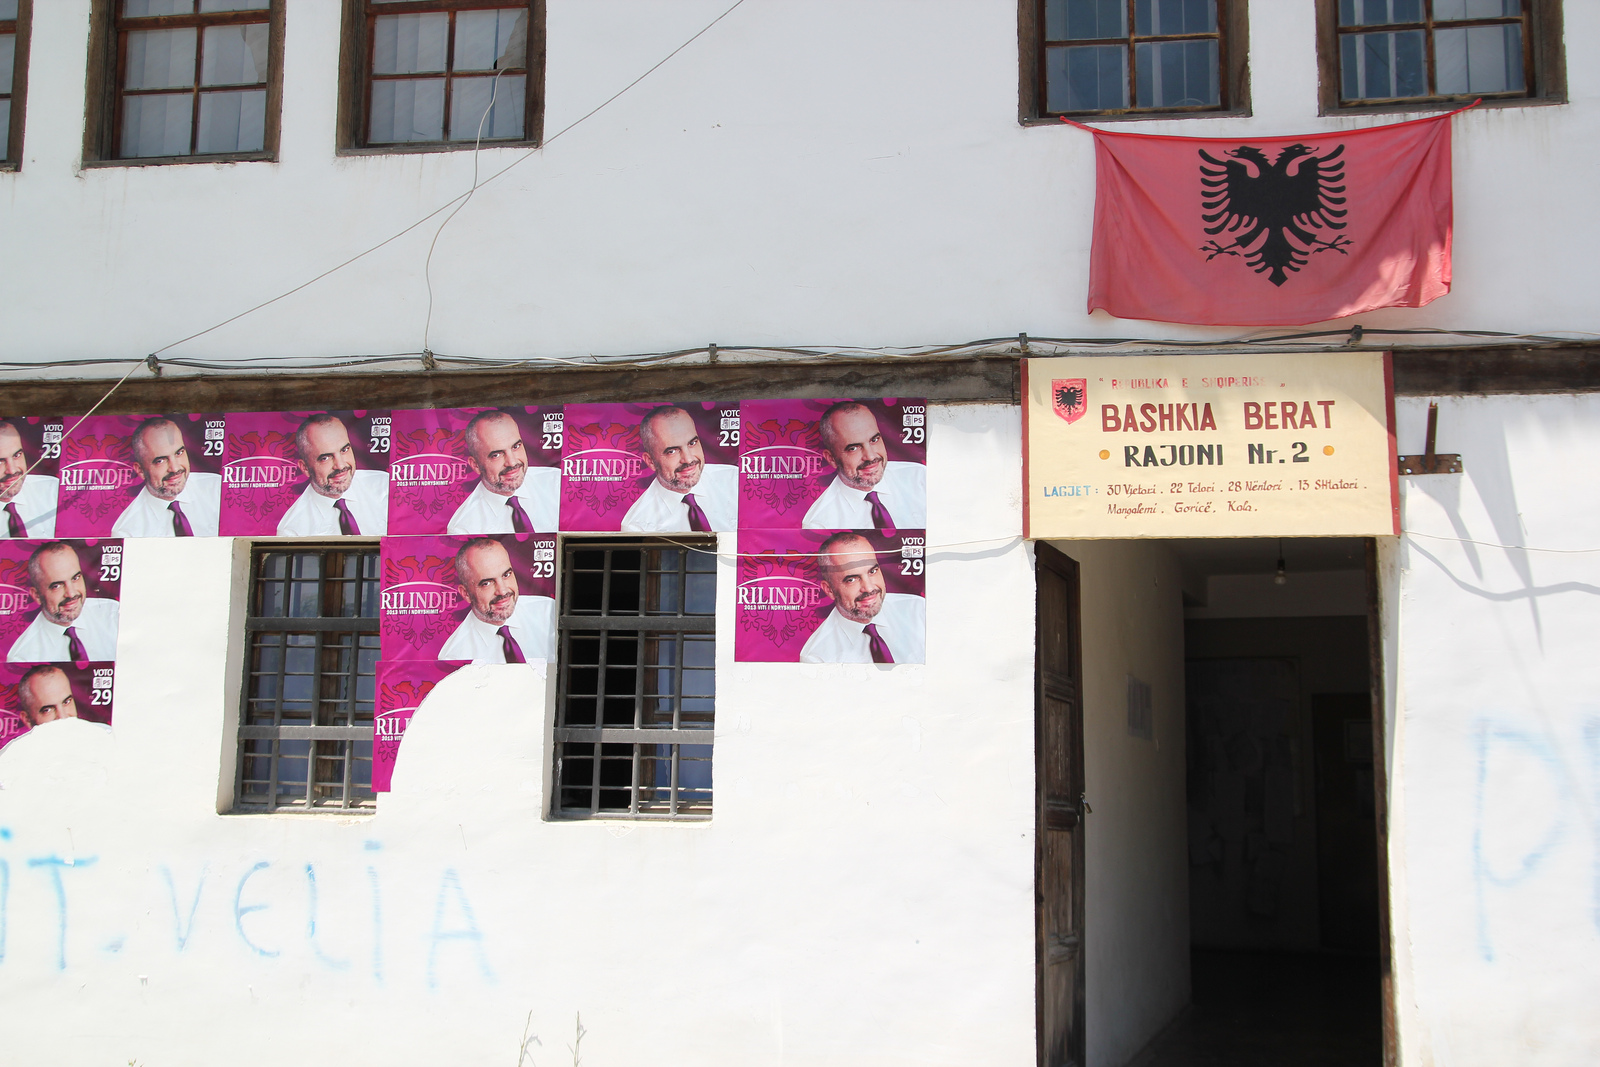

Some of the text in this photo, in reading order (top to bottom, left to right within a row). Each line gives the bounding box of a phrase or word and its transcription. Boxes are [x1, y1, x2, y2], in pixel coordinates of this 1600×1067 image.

[1182, 378, 1188, 388] E
[1101, 400, 1336, 432] BASHKIA BERAT
[542, 434, 563, 449] 29
[719, 431, 740, 446] 29
[902, 427, 924, 444] 29
[41, 444, 61, 458] 29
[204, 441, 224, 456] 29
[370, 438, 390, 453] 29
[1124, 444, 1224, 467] RAJONI
[390, 463, 468, 484] RILINDJE
[562, 459, 642, 480] RILINDJE
[740, 456, 823, 477] RILINDJE
[60, 468, 133, 488] RILINDJE
[222, 466, 298, 486] RILINDJE
[1106, 484, 1121, 496] 30
[1170, 482, 1183, 494] 22
[1228, 481, 1242, 492] 28
[1298, 480, 1310, 490] 13
[100, 566, 120, 581] 29
[533, 562, 554, 578] 29
[901, 559, 924, 575] 29
[381, 592, 458, 613] RILINDJE
[738, 587, 821, 609] RILINDJE
[91, 690, 112, 705] 29
